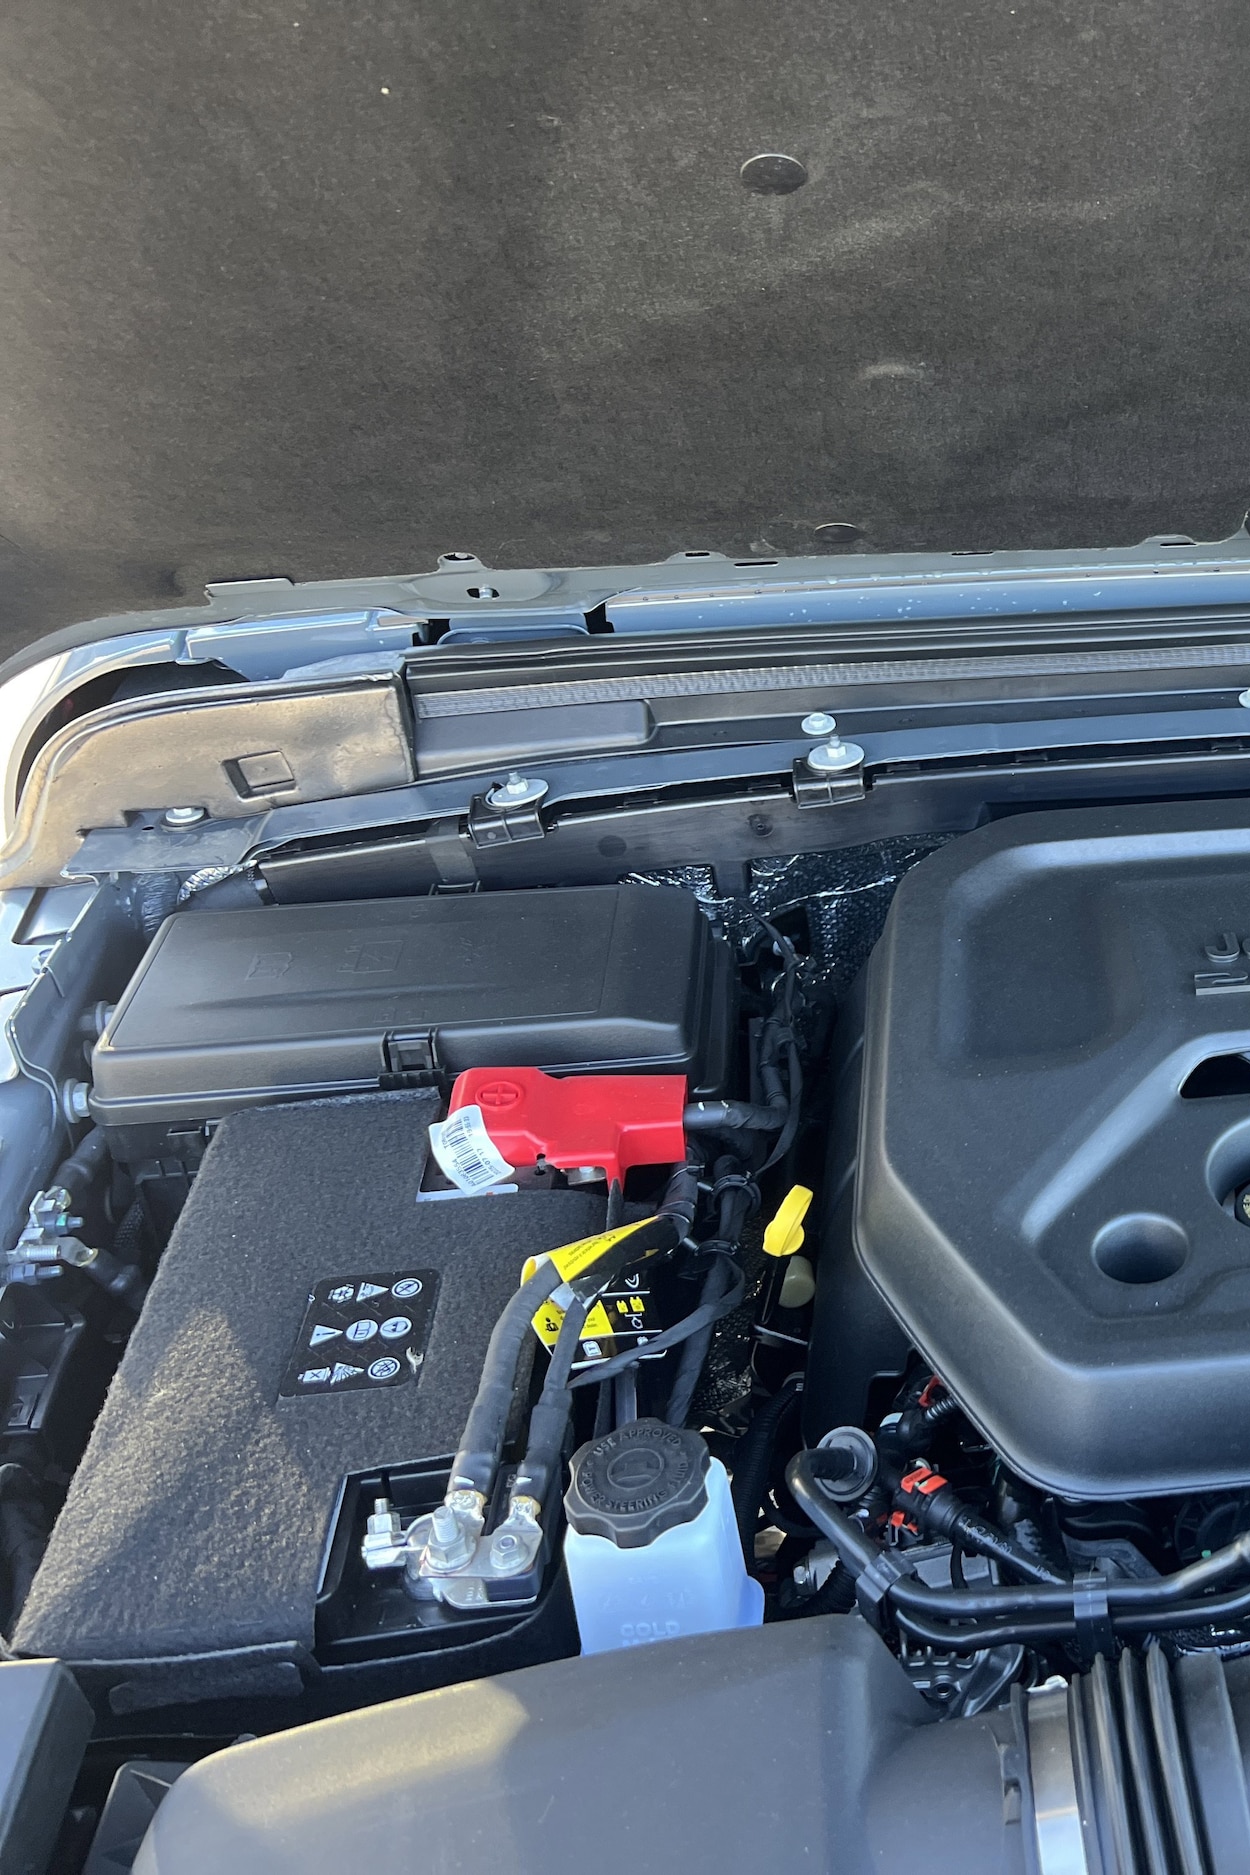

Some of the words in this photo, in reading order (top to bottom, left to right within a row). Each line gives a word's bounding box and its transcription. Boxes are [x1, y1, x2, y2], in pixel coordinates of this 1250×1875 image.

[593, 1437, 617, 1457] USE
[619, 1427, 682, 1448] APPROVED
[605, 1489, 668, 1512] STEERING
